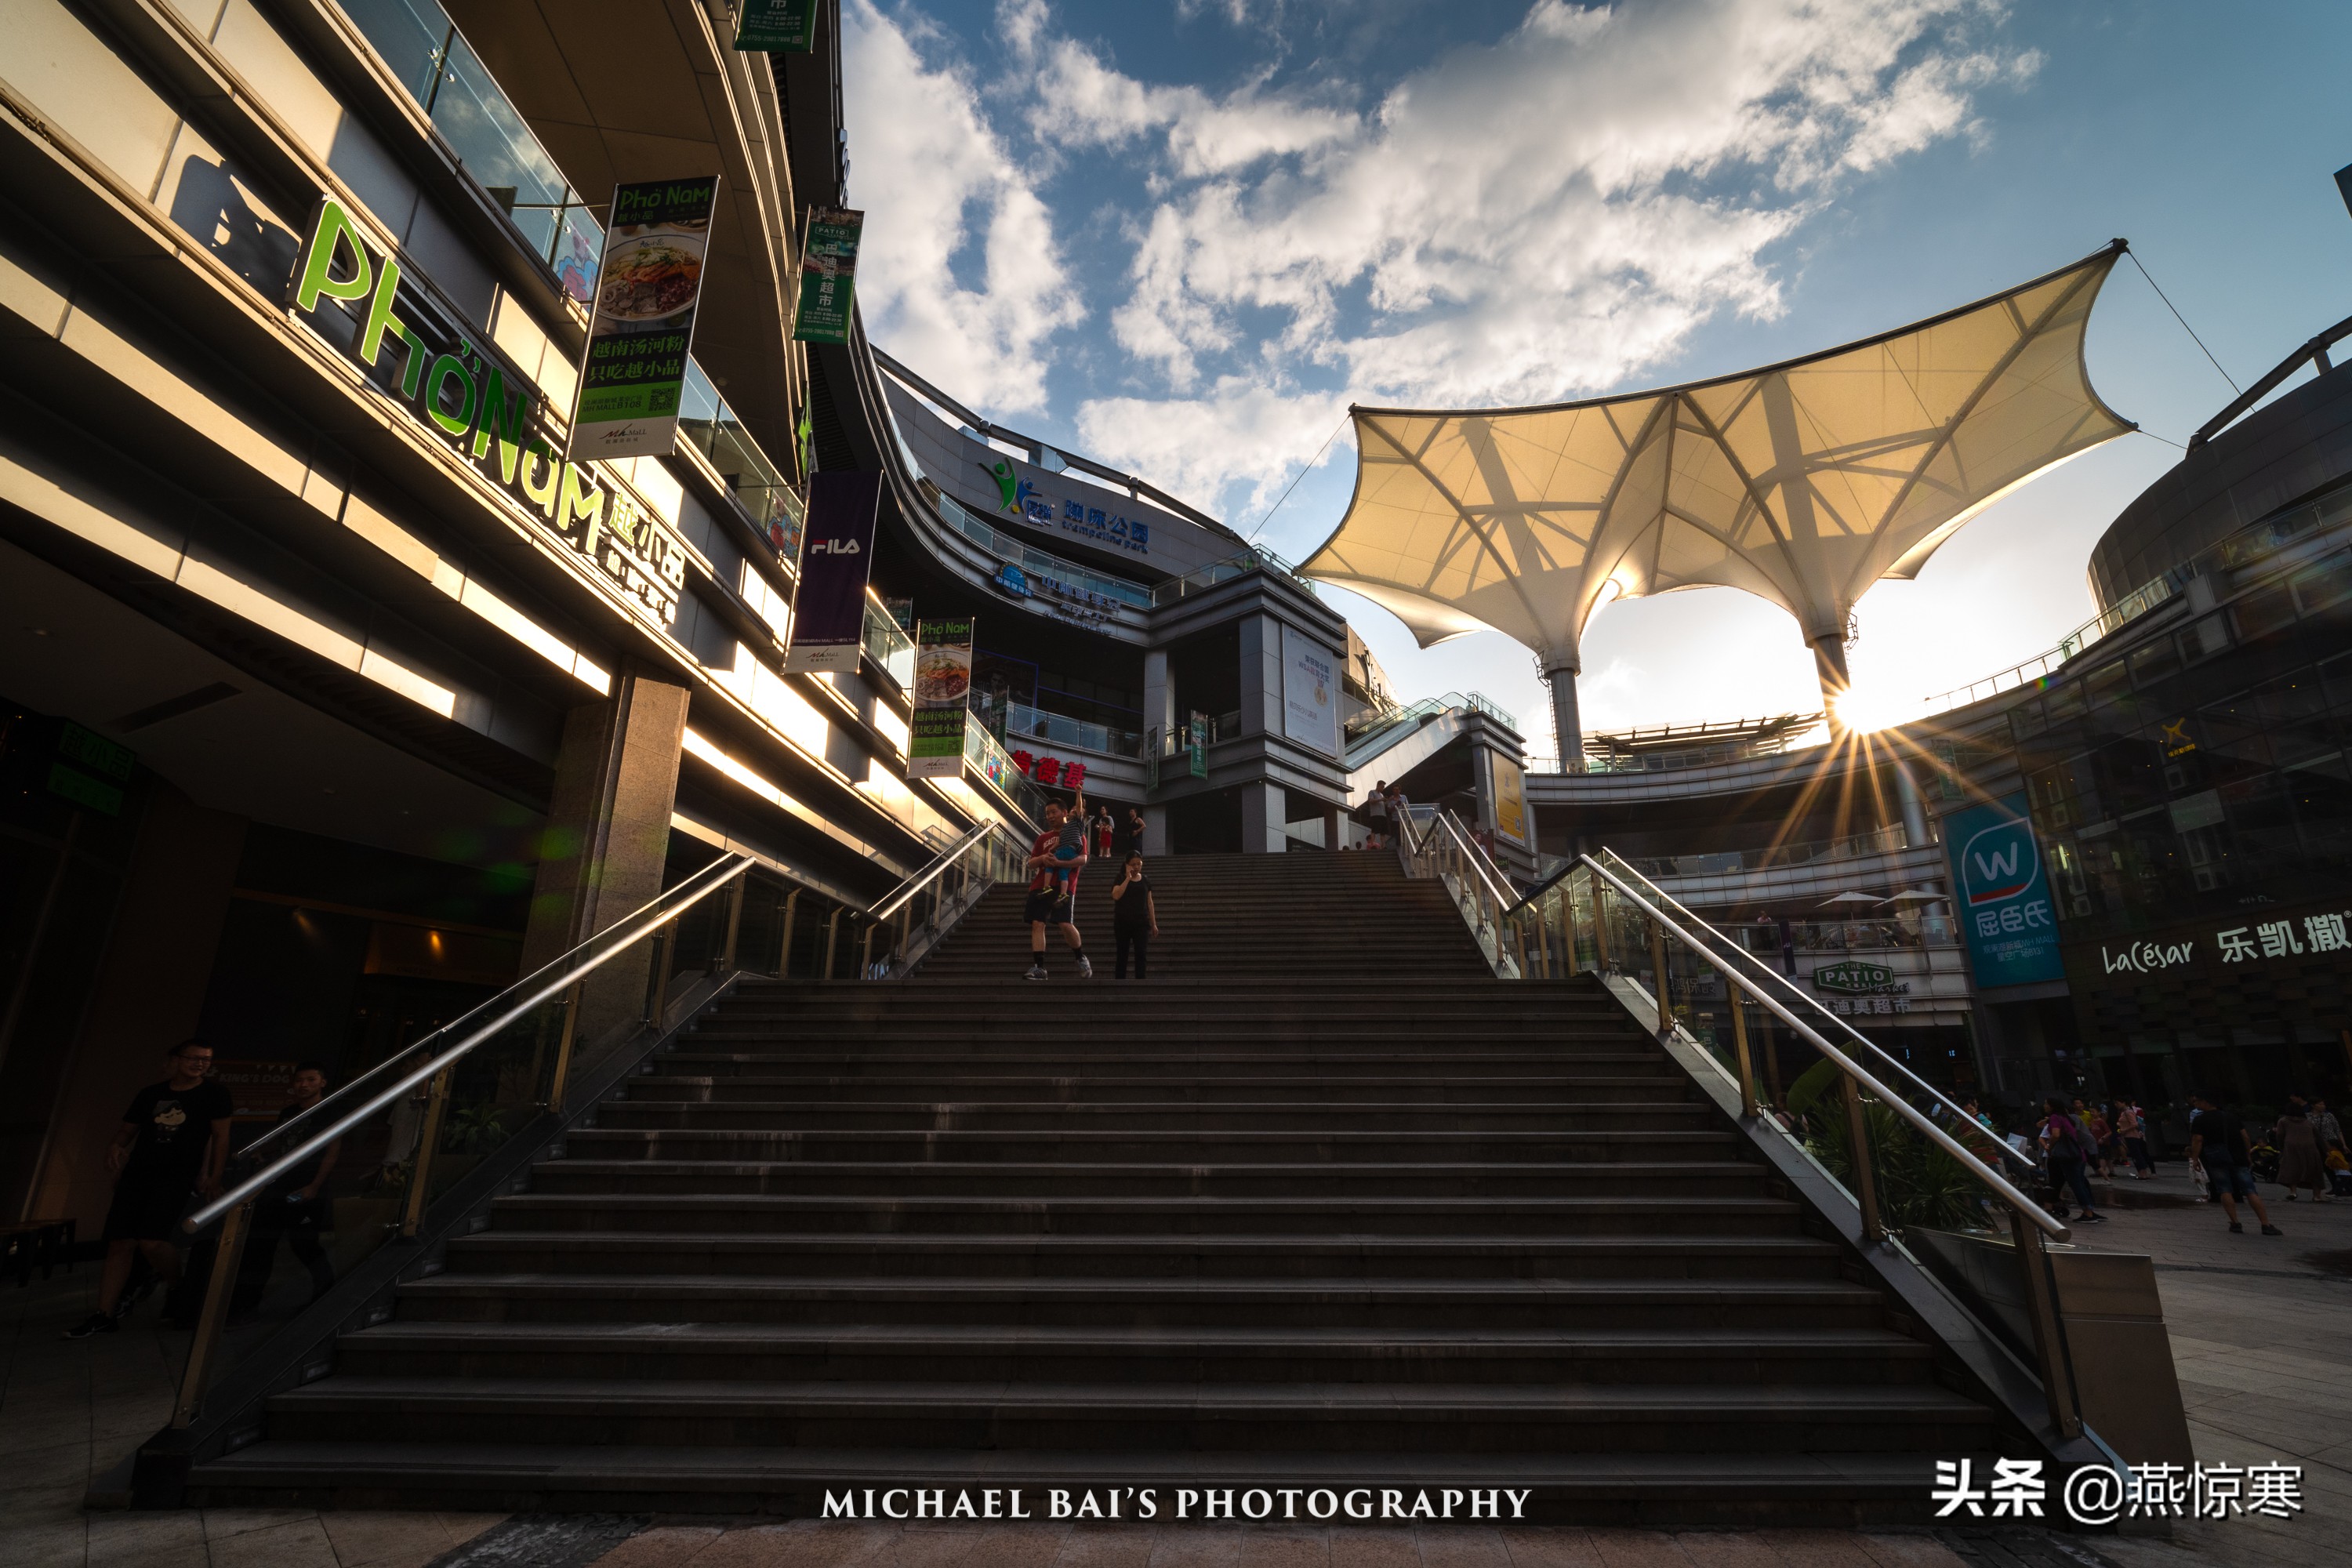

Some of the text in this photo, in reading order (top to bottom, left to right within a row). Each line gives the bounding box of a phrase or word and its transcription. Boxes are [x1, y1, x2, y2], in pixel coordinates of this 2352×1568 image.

[617, 210, 655, 223] 越小品
[818, 227, 846, 236] PATIO
[818, 243, 839, 307] 巴迪奥超市
[592, 335, 685, 358] 越南汤河粉
[588, 358, 681, 383] 只吃越小品
[1065, 499, 1149, 544] 蹦床公园
[608, 492, 686, 590] 越小品
[811, 539, 861, 555] FILA
[1124, 539, 1149, 554] park
[915, 710, 964, 721] 越南汤河粉
[914, 724, 962, 735] 只吃越小品
[1974, 841, 2018, 881] W
[1976, 899, 2050, 938] 屈臣氏
[2035, 934, 2056, 944] MALL
[2217, 913, 2352, 964] 乐凯撒
[1824, 970, 1885, 982] PATIO
[1868, 982, 1910, 993] Market
[219, 1073, 290, 1083] KING'S DOG
